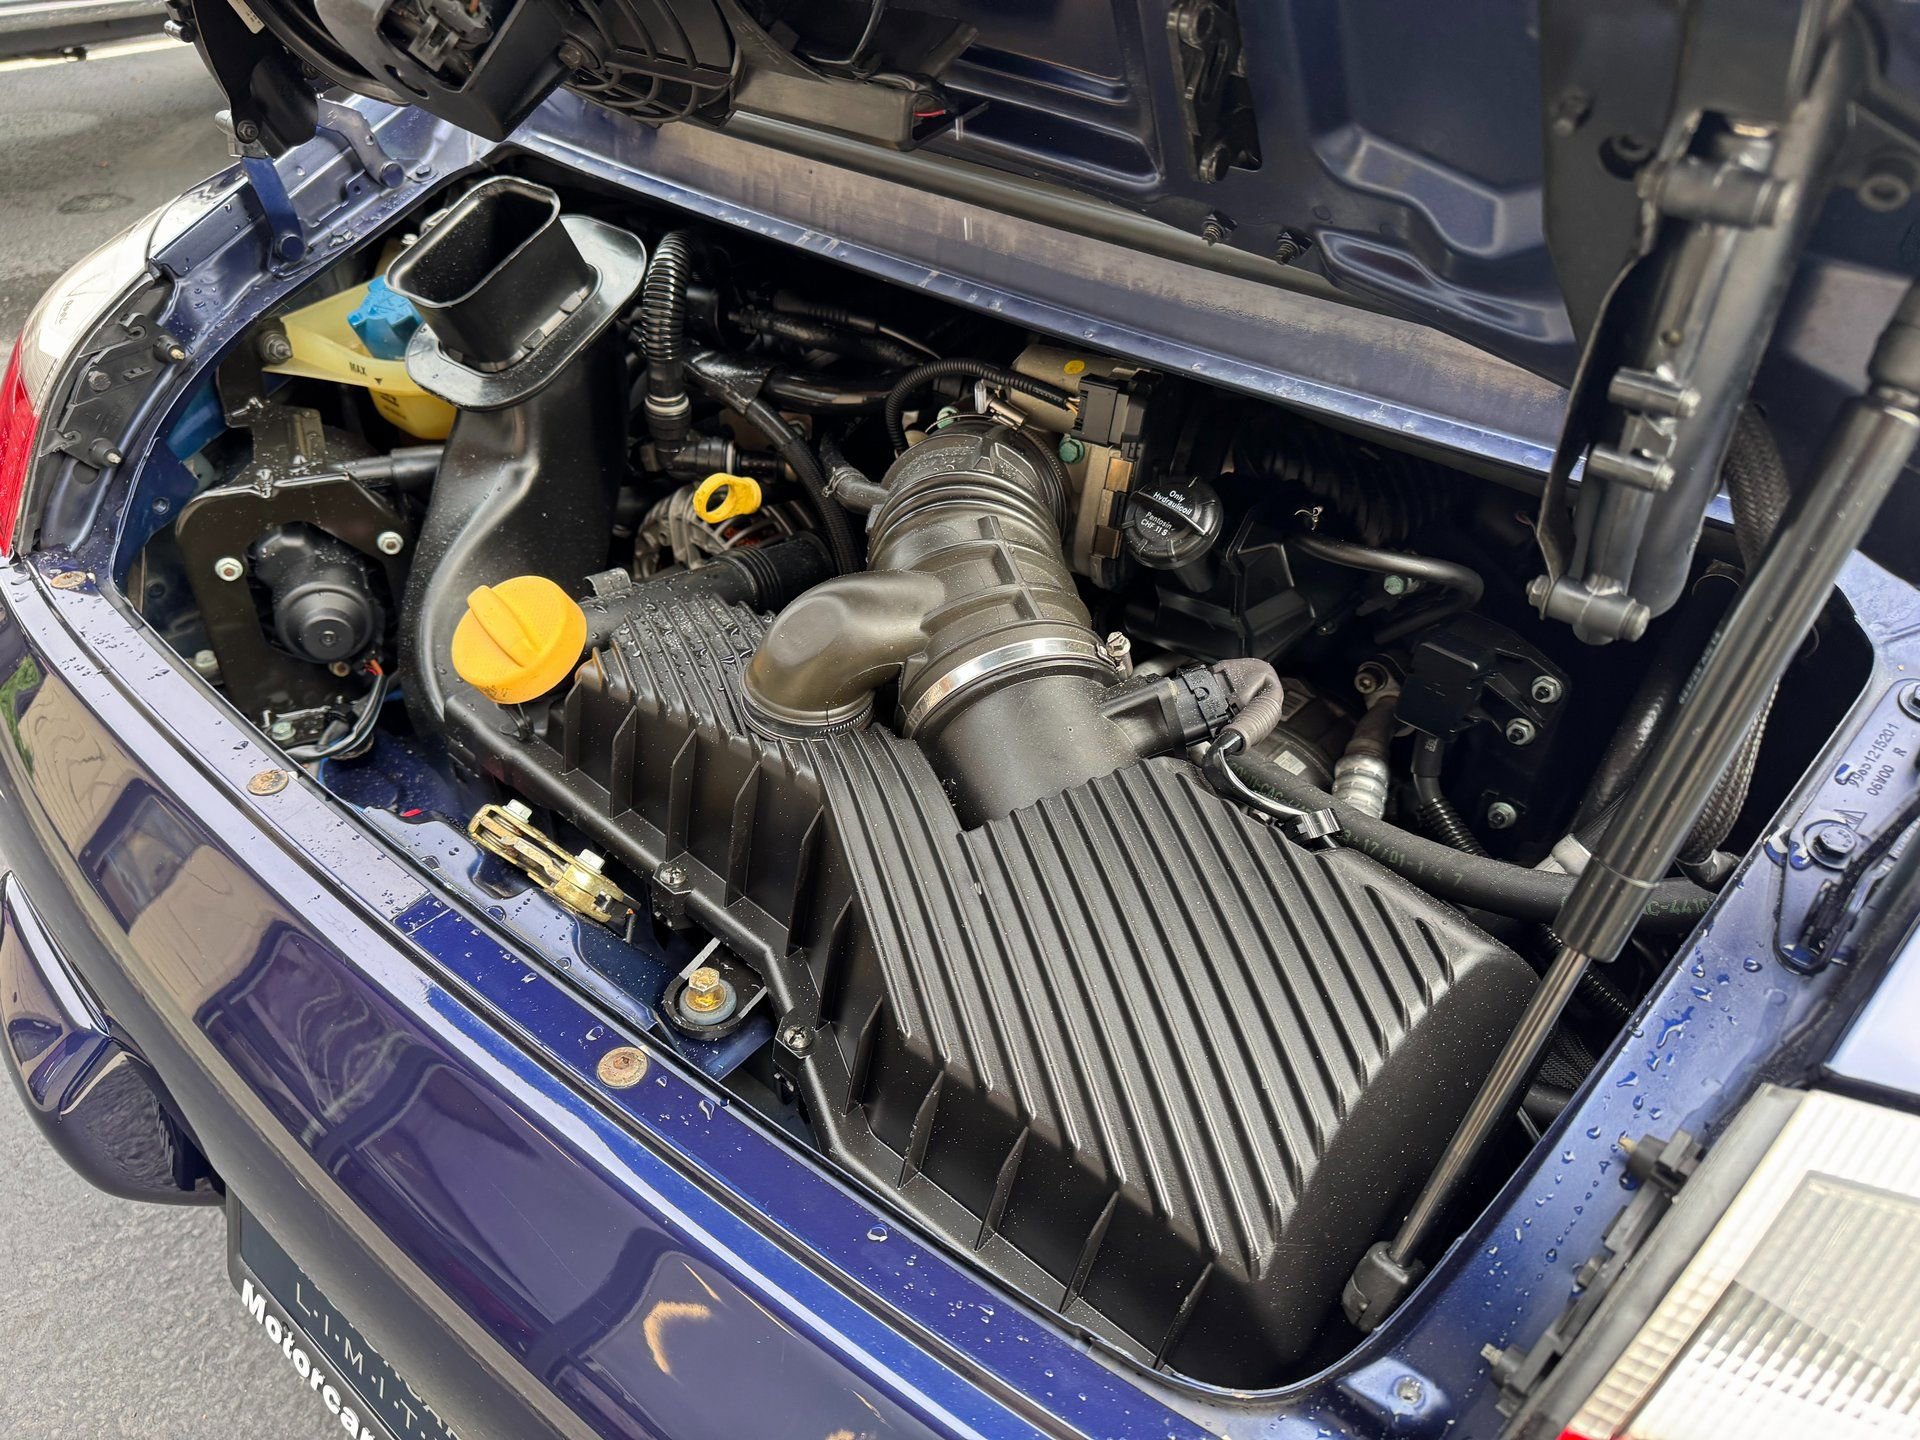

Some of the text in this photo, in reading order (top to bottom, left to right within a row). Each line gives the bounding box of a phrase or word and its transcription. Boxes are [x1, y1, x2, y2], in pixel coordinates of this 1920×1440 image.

[348, 361, 367, 376] MAX
[1169, 490, 1185, 503] Only
[1140, 518, 1155, 529] CHF
[1145, 511, 1172, 530] Pentosin
[1892, 747, 1908, 757] R
